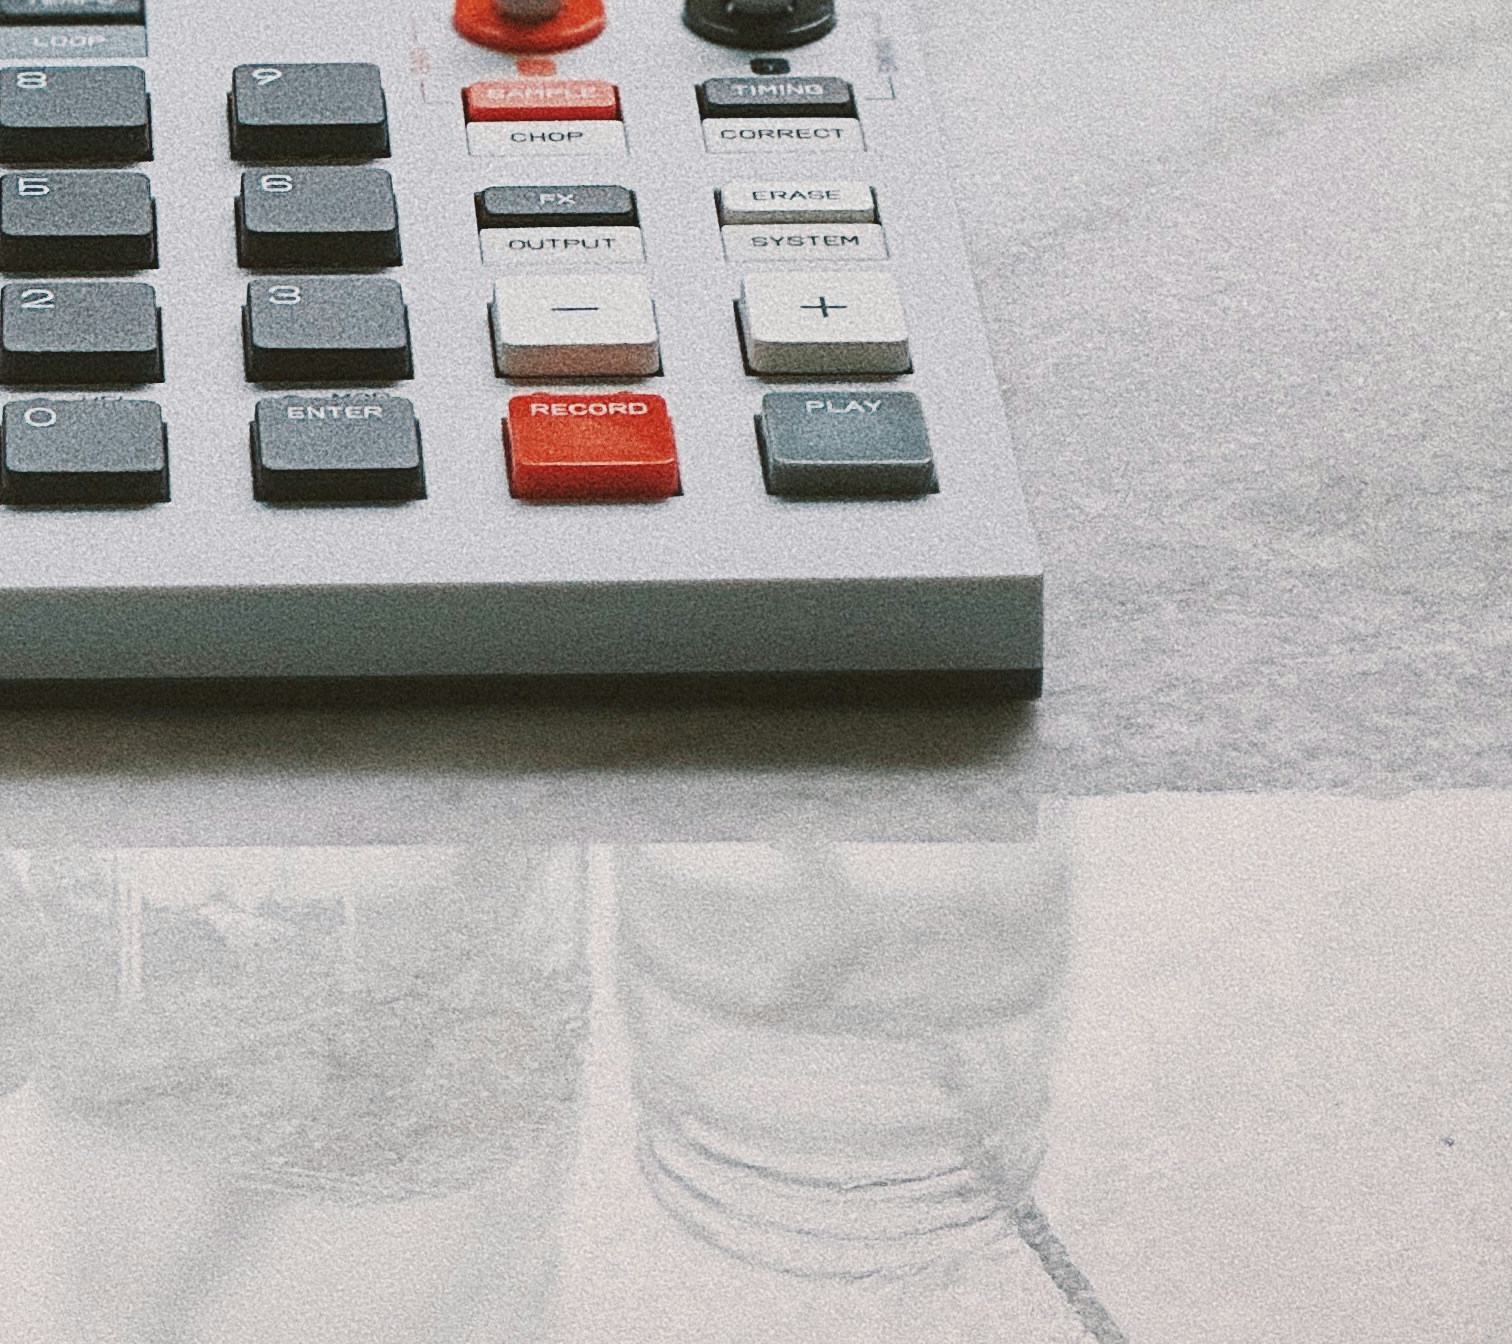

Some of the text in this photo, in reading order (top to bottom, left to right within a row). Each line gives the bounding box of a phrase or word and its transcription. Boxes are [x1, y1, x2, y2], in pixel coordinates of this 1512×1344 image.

[16, 71, 47, 90] 8
[252, 68, 282, 85] 9
[735, 84, 824, 96] TIMING
[510, 131, 584, 143] CHOP
[720, 128, 844, 140] CORRECT
[18, 177, 50, 196] 5
[260, 174, 292, 193] 6
[539, 193, 576, 205] FX
[752, 190, 841, 201] ERASE
[508, 238, 616, 250] OUTPUT
[751, 236, 860, 247] SYSTEM
[20, 288, 55, 309] 2
[268, 285, 301, 305] 3
[287, 406, 383, 419] ENTER
[530, 402, 648, 416] RECORD
[805, 400, 882, 413] PLAY
